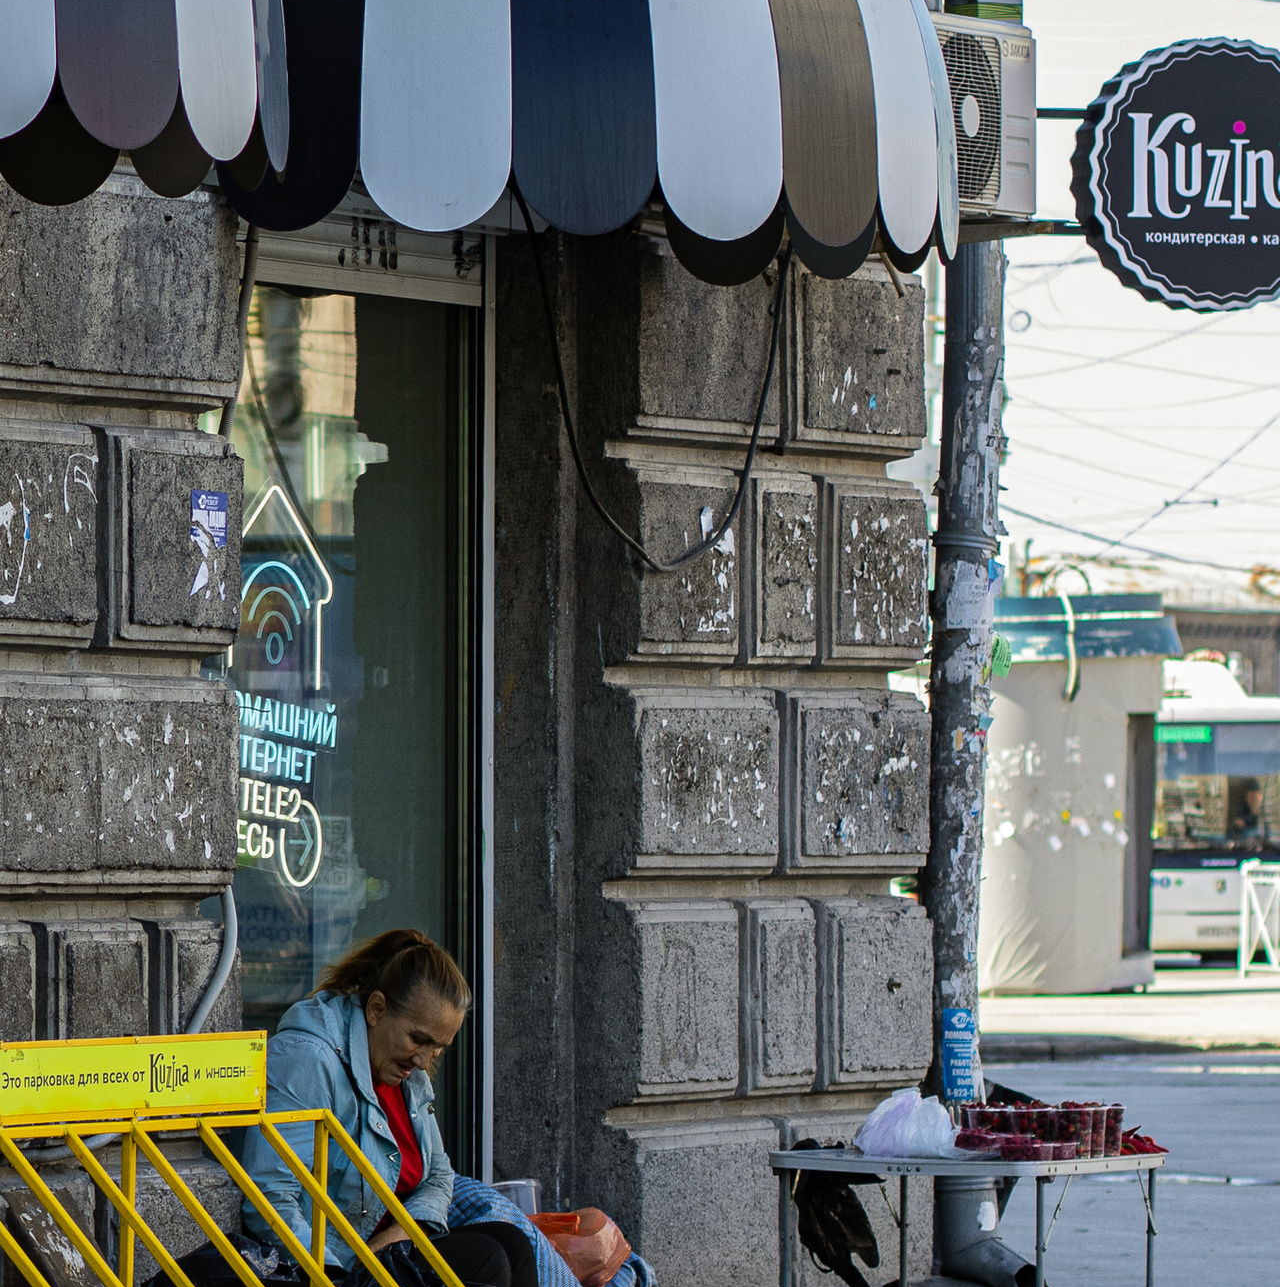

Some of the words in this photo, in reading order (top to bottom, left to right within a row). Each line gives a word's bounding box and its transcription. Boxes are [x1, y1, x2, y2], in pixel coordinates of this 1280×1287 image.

[1127, 112, 1280, 220] Kuzin
[1145, 232, 1245, 247] кондитерская
[1263, 234, 1280, 245] ка
[234, 690, 338, 748] ОМАШНИЙ
[239, 734, 317, 784] ТЕРНЕТ
[239, 777, 302, 823] TELE2
[237, 819, 275, 859] ЕСЬ
[1, 1071, 21, 1089] Это
[23, 1074, 75, 1092] парковка
[77, 1072, 99, 1088] для
[102, 1071, 129, 1084] всех
[132, 1070, 145, 1083] от
[148, 1053, 190, 1093] Kuzina
[194, 1069, 201, 1080] и
[205, 1065, 246, 1079] WHOOSH
